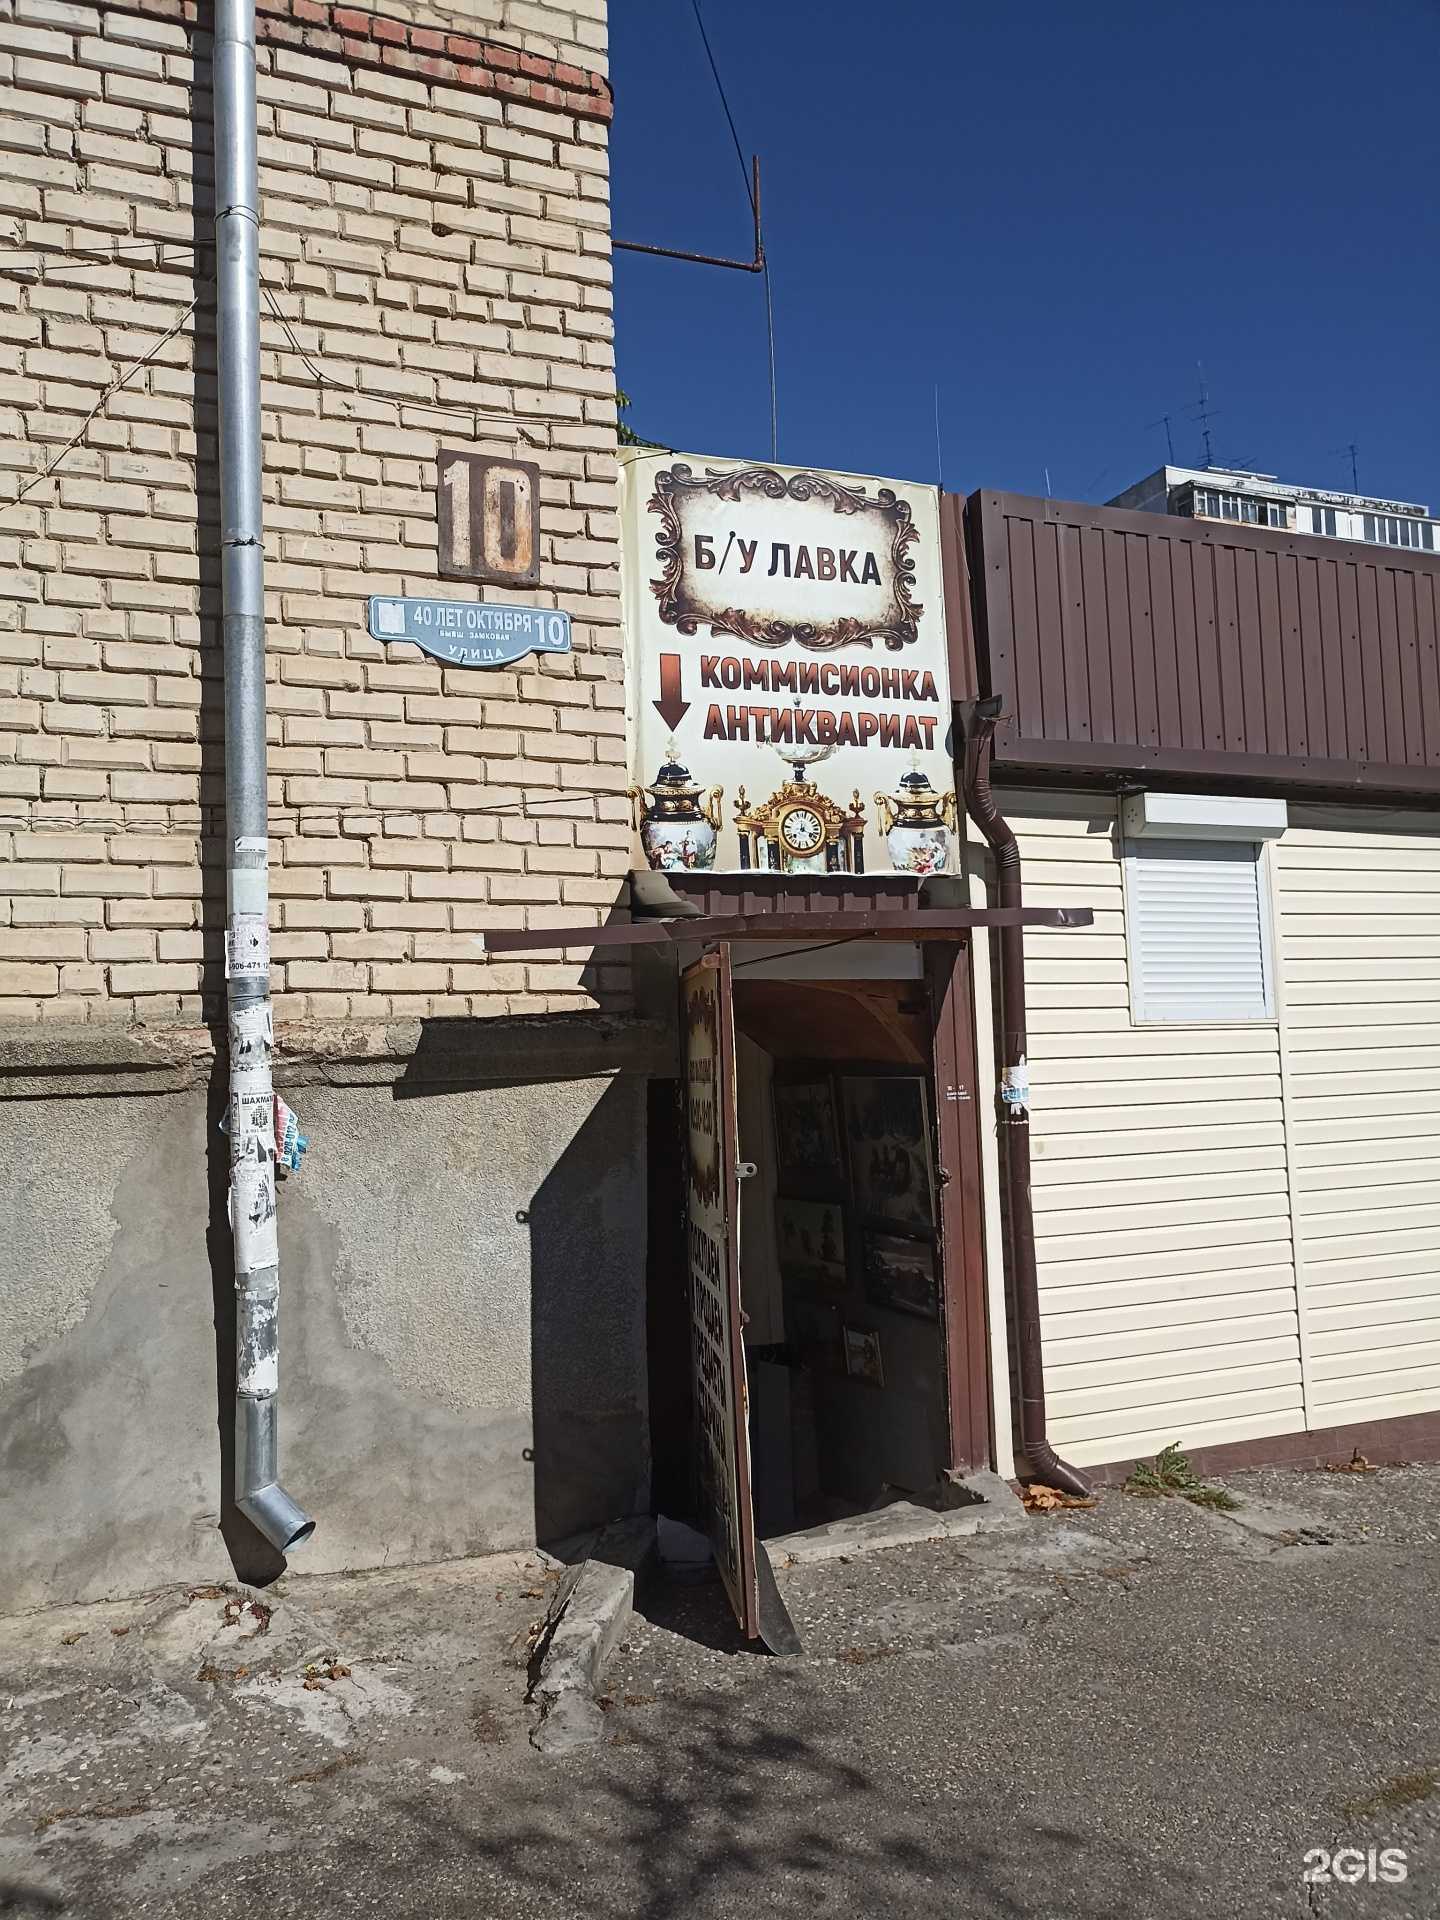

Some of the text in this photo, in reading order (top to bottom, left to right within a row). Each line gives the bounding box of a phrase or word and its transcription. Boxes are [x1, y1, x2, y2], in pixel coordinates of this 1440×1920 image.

[444, 460, 532, 573] 10
[694, 531, 882, 586] Б/У ЛАВКА
[414, 606, 565, 645] 40 ЛЕТ ОКТЯБРЯ 10
[448, 644, 505, 661] УЛИЦА
[700, 655, 940, 702] КОММИСИОНКА
[703, 703, 938, 751] АНТИКВАРИАТ
